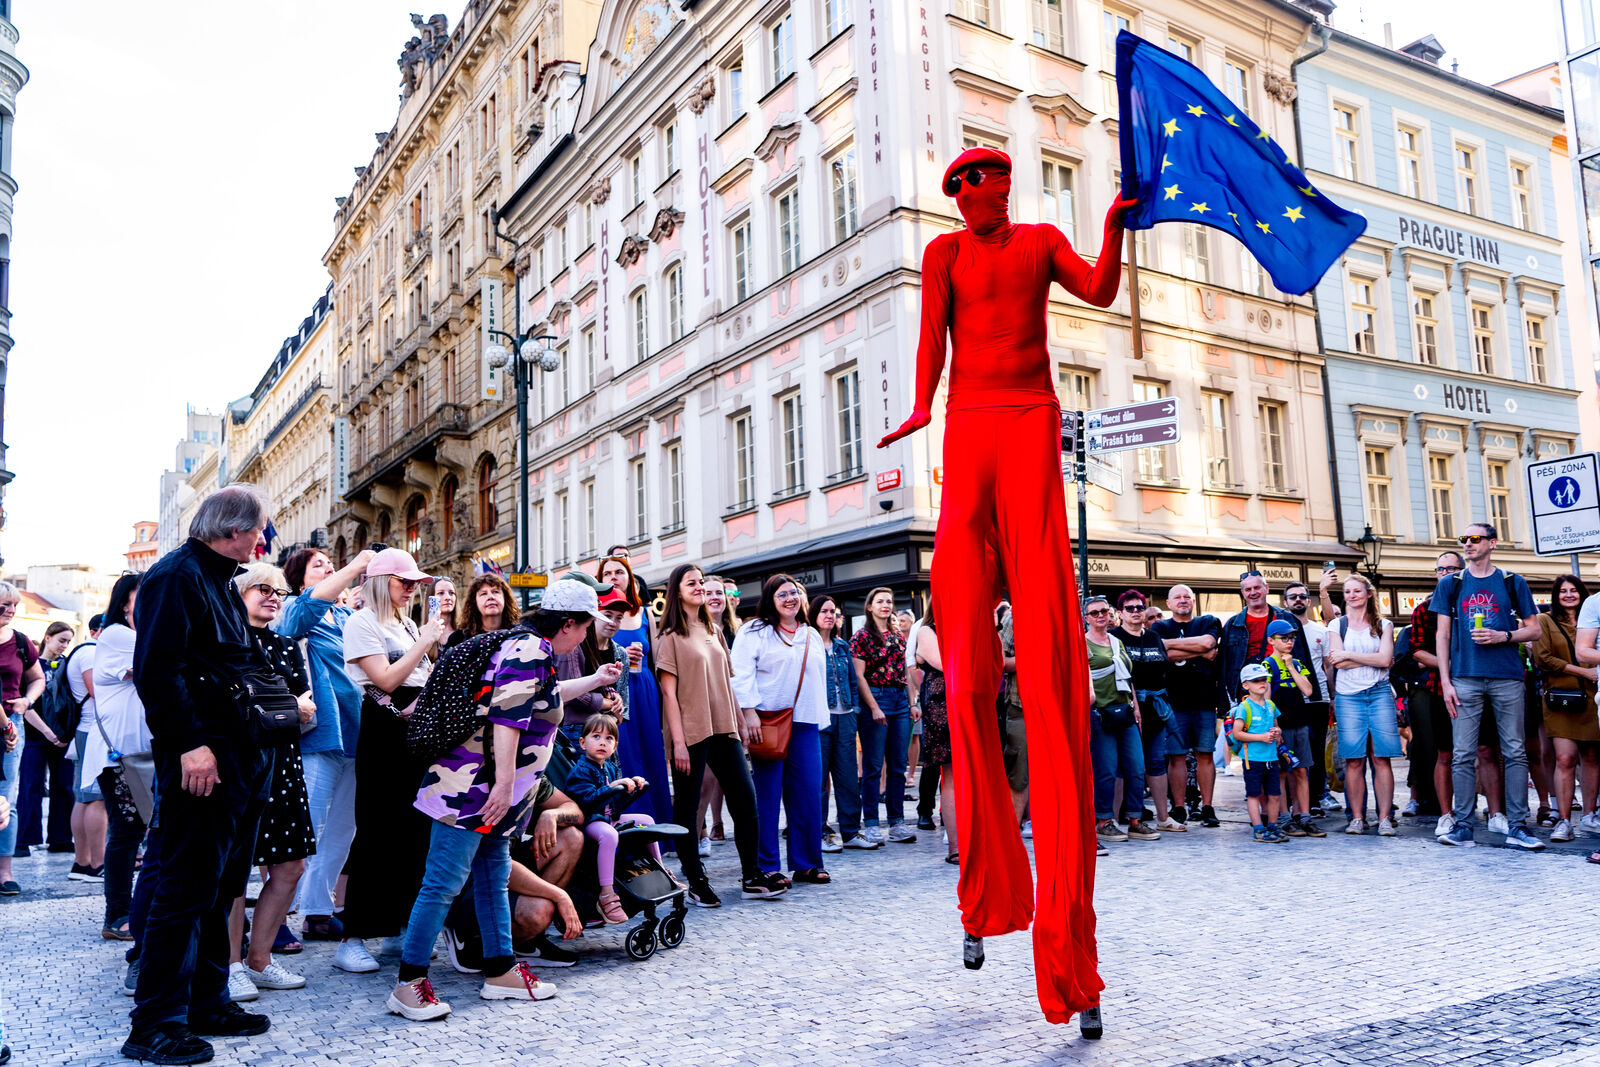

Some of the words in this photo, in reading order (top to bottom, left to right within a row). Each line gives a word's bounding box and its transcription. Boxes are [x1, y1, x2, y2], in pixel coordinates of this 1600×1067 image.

[869, 0, 877, 91] RAGUE
[920, 0, 931, 91] RAGUE
[927, 114, 935, 163] INN
[698, 133, 710, 297] HOTEL
[1399, 217, 1464, 256] PRAGUE
[1470, 236, 1500, 265] INN
[601, 219, 609, 361] HOTEL
[881, 360, 889, 448] HOTE
[1443, 384, 1491, 414] HOTEL
[1102, 413, 1120, 424] Obecní
[1123, 411, 1135, 421] dům
[1103, 436, 1123, 446] Prašná
[1126, 433, 1143, 443] brána
[1536, 466, 1557, 478] PĚŠÍ
[1561, 461, 1587, 474] ZÓNA
[1074, 560, 1110, 572] ADORA
[1263, 568, 1293, 578] PANDORA
[1468, 593, 1495, 605] ADV
